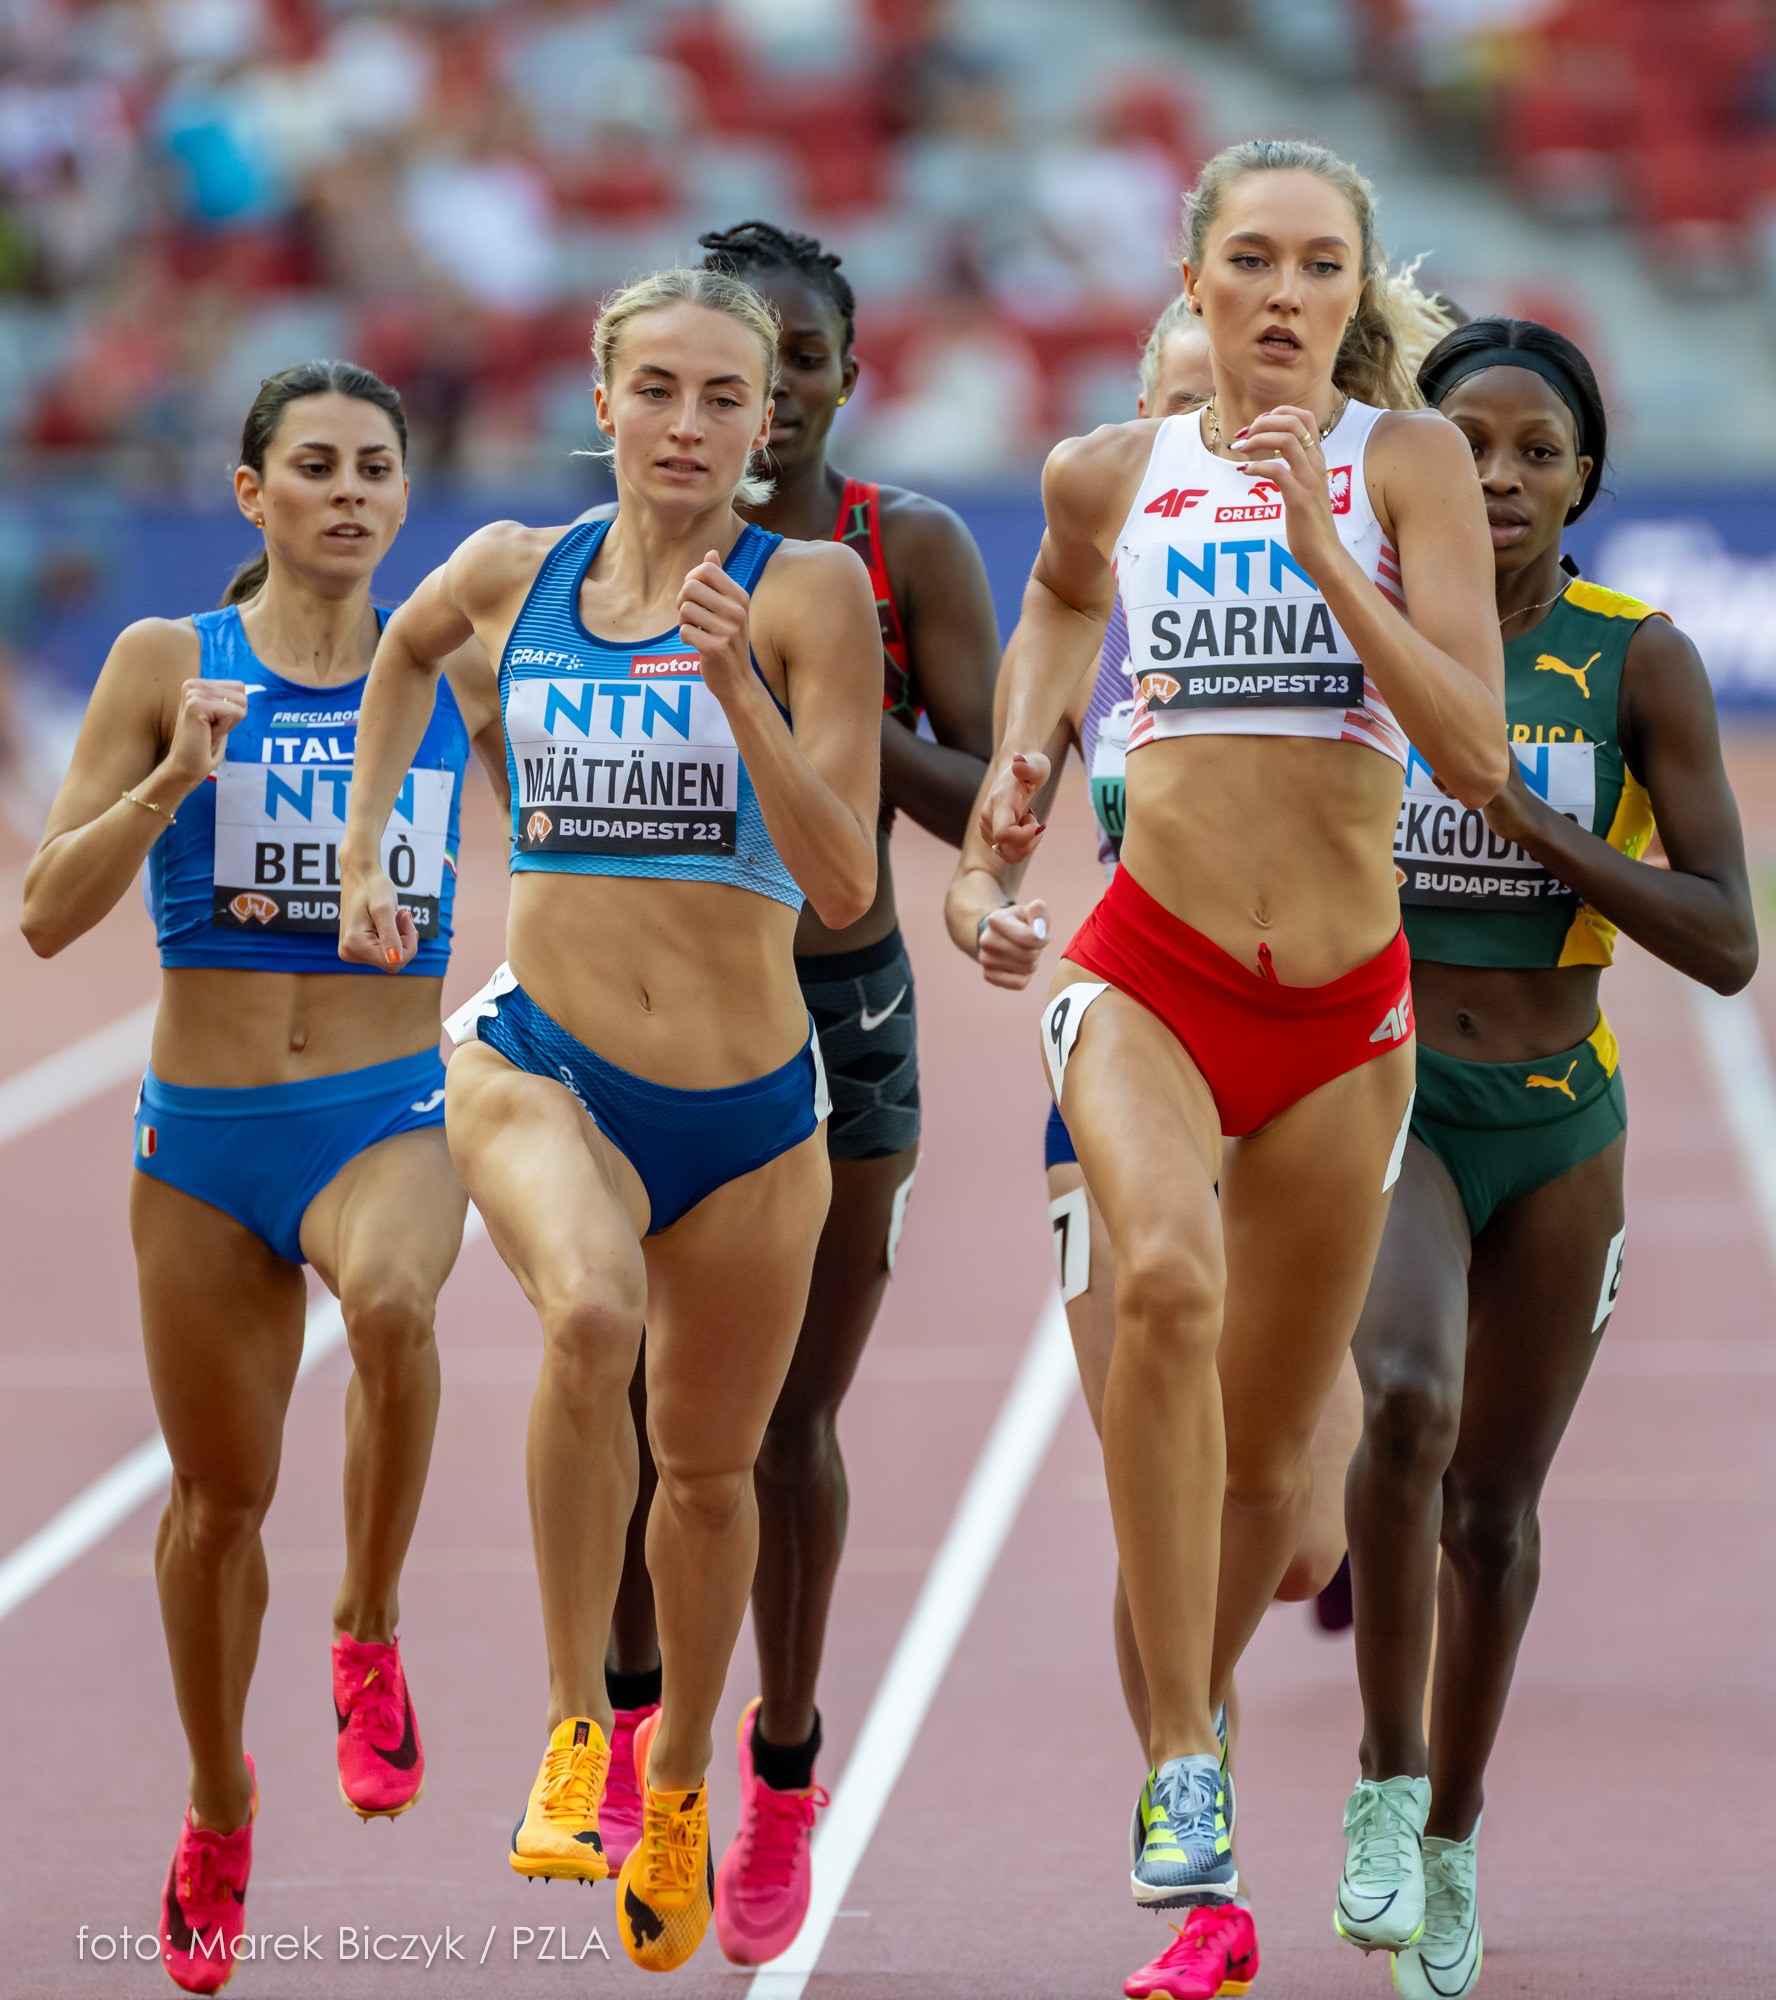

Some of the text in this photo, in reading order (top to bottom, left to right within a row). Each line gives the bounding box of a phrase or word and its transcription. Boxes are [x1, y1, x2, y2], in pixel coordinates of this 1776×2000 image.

[1144, 488, 1209, 518] 4F
[1219, 507, 1278, 521] ORLEN
[1150, 603, 1338, 661] SARNA
[511, 649, 568, 668] CRAFT
[1188, 675, 1349, 696] BUDAPEST 23
[543, 682, 692, 741] NTN
[523, 746, 724, 807] MÄÄTTÄNEN
[559, 818, 721, 840] BUDAPEST 23
[254, 834, 416, 888] BELÒ
[1414, 872, 1545, 897] BUDAPEST
[1050, 997, 1072, 1068] 9
